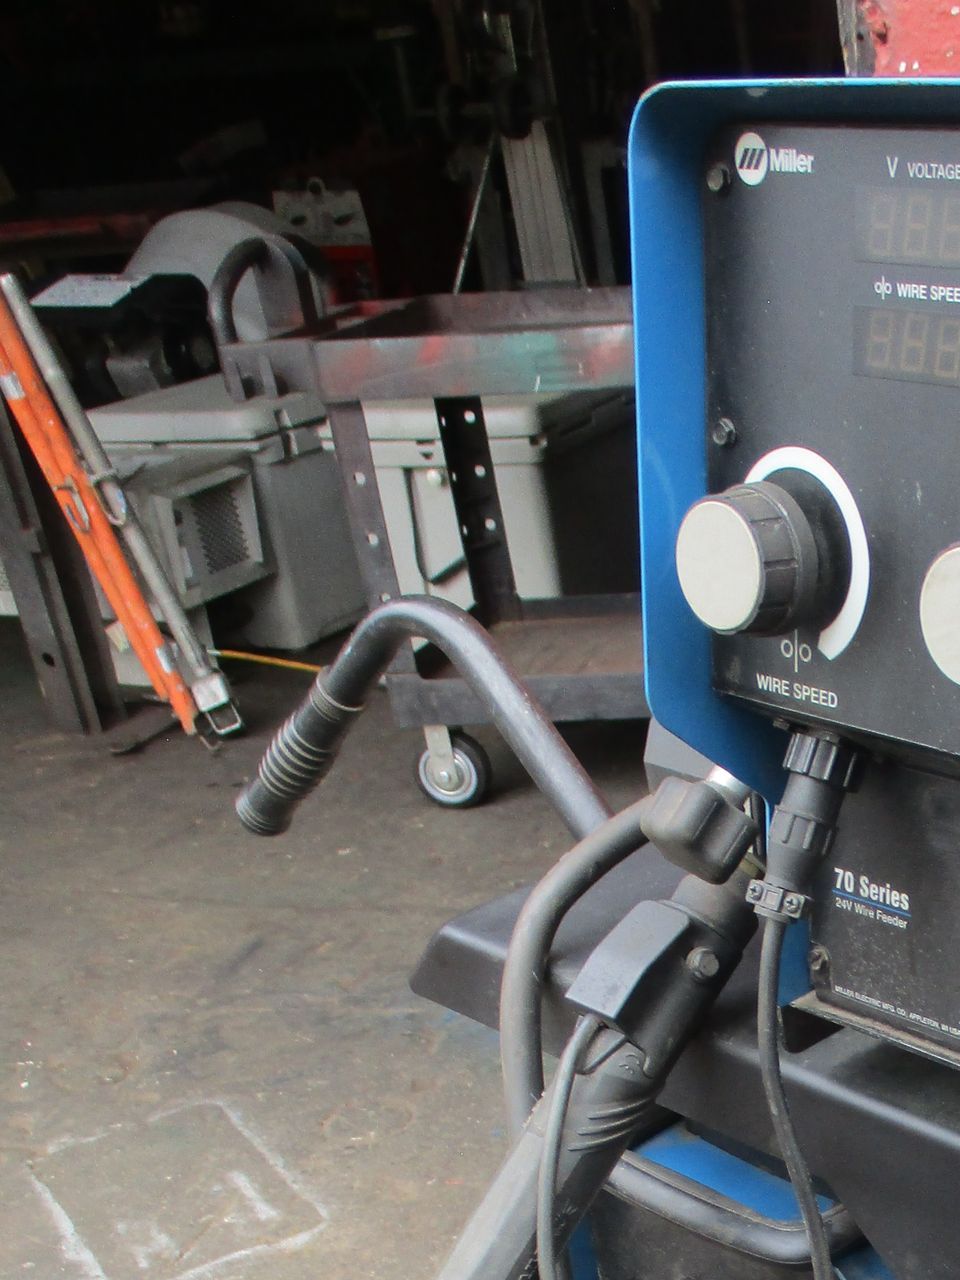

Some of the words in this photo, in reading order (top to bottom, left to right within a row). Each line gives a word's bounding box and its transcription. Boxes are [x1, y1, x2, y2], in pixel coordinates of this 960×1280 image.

[768, 149, 815, 174] Miller
[896, 282, 928, 300] WIRE
[756, 672, 790, 697] WIRE
[792, 682, 838, 708] SPEED
[833, 866, 855, 893] 70
[859, 875, 910, 911] Series
[835, 897, 853, 911] 24V
[854, 902, 875, 919] Wire
[876, 909, 908, 929] Feeder
